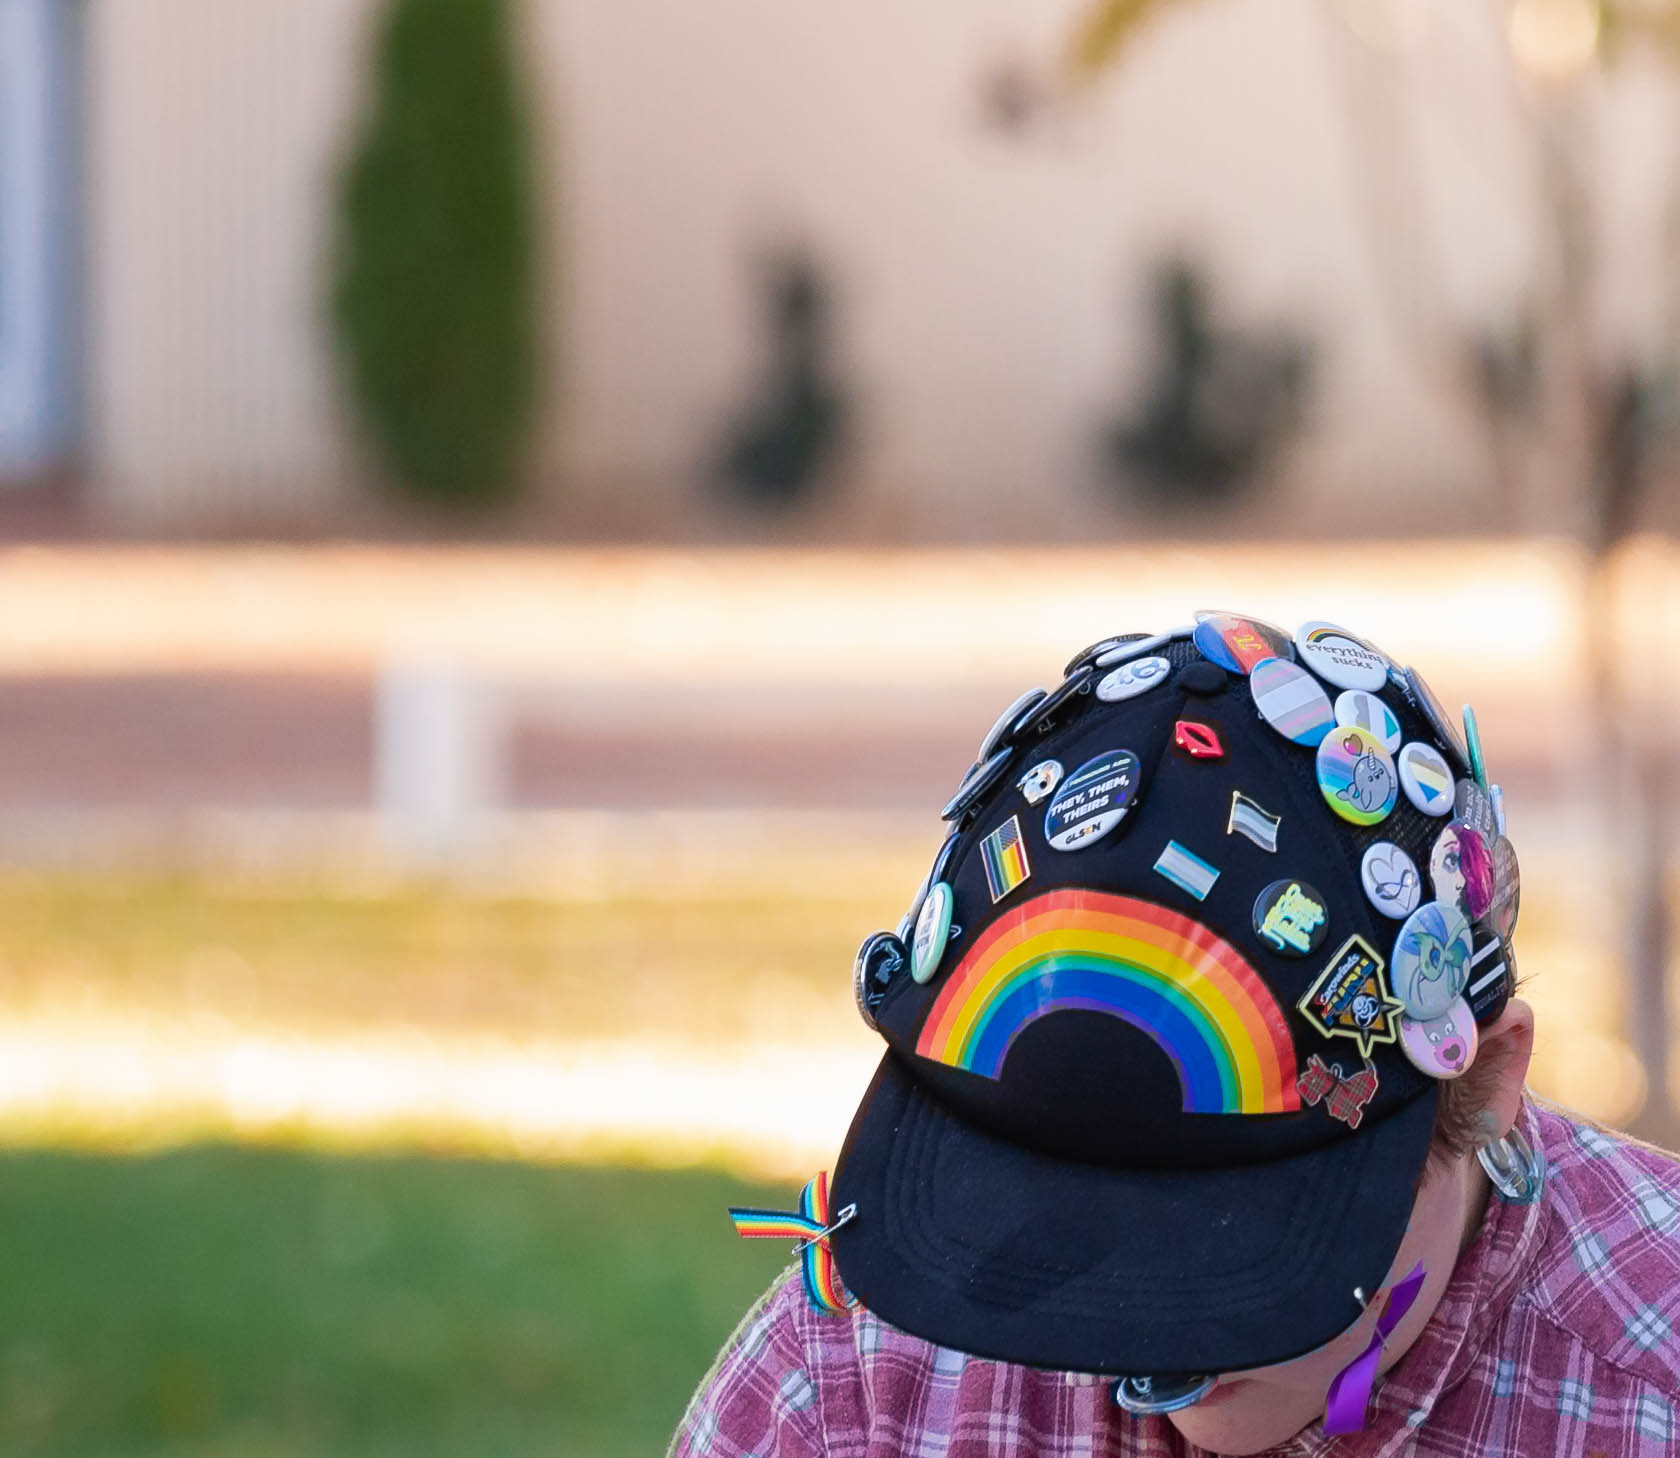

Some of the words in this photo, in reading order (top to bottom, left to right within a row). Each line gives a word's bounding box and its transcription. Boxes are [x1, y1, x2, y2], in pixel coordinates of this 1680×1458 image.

[1332, 657, 1373, 670] sucks
[1051, 792, 1085, 817] THEY,
[1088, 774, 1130, 798] THEM,
[1063, 795, 1109, 824] THEIRS
